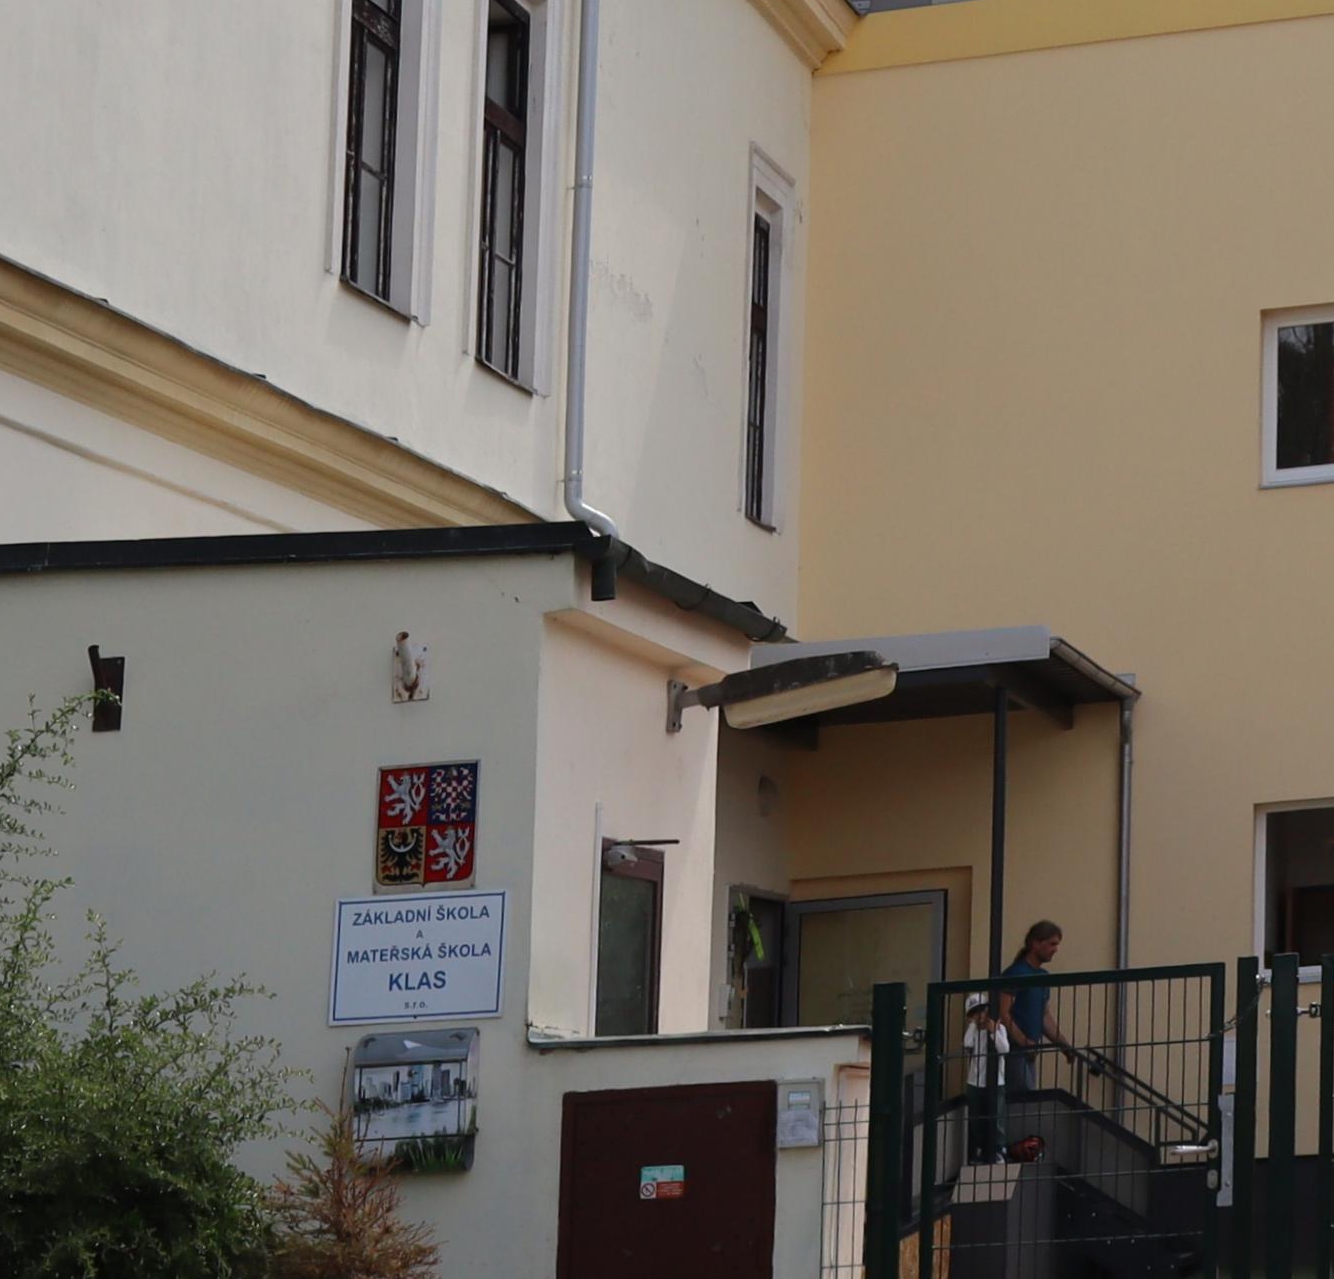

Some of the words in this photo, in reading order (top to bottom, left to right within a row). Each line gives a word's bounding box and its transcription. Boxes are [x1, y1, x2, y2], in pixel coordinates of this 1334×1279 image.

[352, 905, 431, 926] ZÁKLADNÍ
[435, 905, 490, 922] ŠKOLA
[416, 929, 424, 939] A
[347, 943, 433, 964] MATEŘSKÁ
[437, 942, 492, 959] ŠKOLA
[388, 970, 447, 992] KLAS
[404, 1001, 428, 1010] s.r.o.
